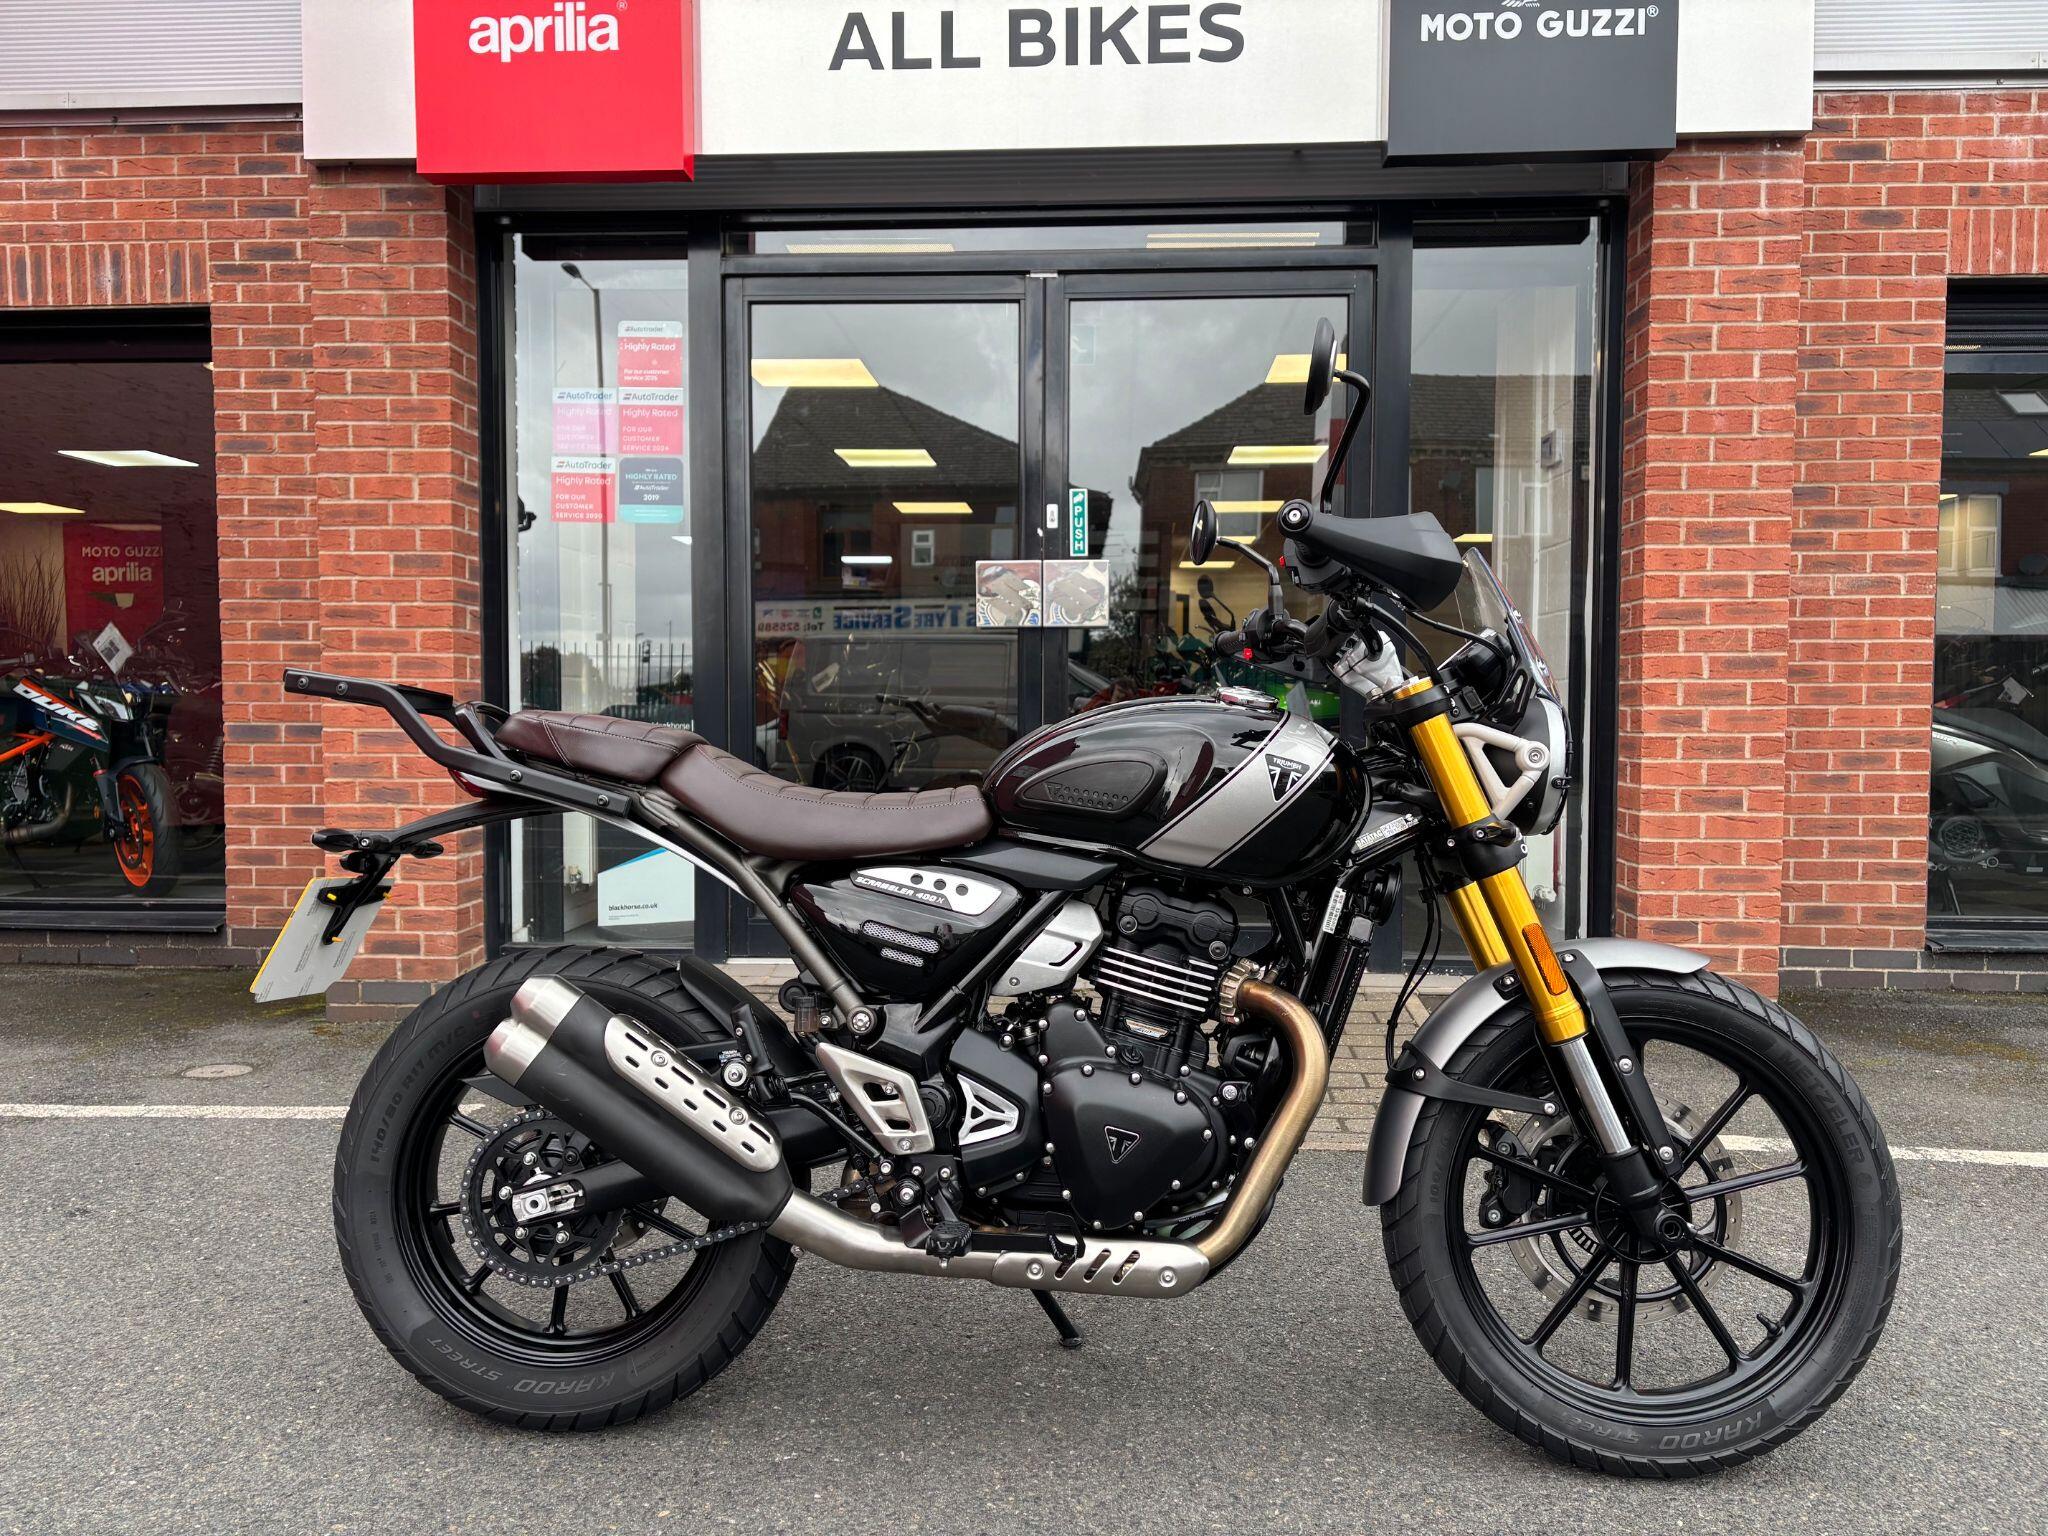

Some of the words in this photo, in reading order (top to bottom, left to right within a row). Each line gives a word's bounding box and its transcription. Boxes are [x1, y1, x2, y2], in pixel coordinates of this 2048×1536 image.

[1420, 11, 1523, 42] MOTO
[828, 10, 982, 71] ALL
[1007, 2, 1246, 68] BIKES
[624, 342, 650, 352] Highly
[651, 342, 676, 351] Rated
[566, 391, 613, 400] AutoTrader
[632, 392, 679, 402] AutoTrader
[623, 408, 650, 419] Highly
[652, 409, 679, 417] Rated
[565, 460, 612, 470] AutoTrader
[555, 476, 584, 486] Highly
[585, 476, 612, 485] Rated
[1074, 505, 1084, 550] PUSH
[81, 546, 120, 558] MOTO
[92, 562, 153, 585] aprilia
[13, 682, 102, 732] DUKE
[1272, 757, 1302, 770] TRIUMPH
[854, 876, 915, 896] SCRAMBLER
[608, 902, 658, 911] blackhorse.co.uk
[426, 1336, 504, 1381] STREET
[512, 1371, 616, 1395] KAROO
[1657, 1411, 1763, 1450] KAROO
